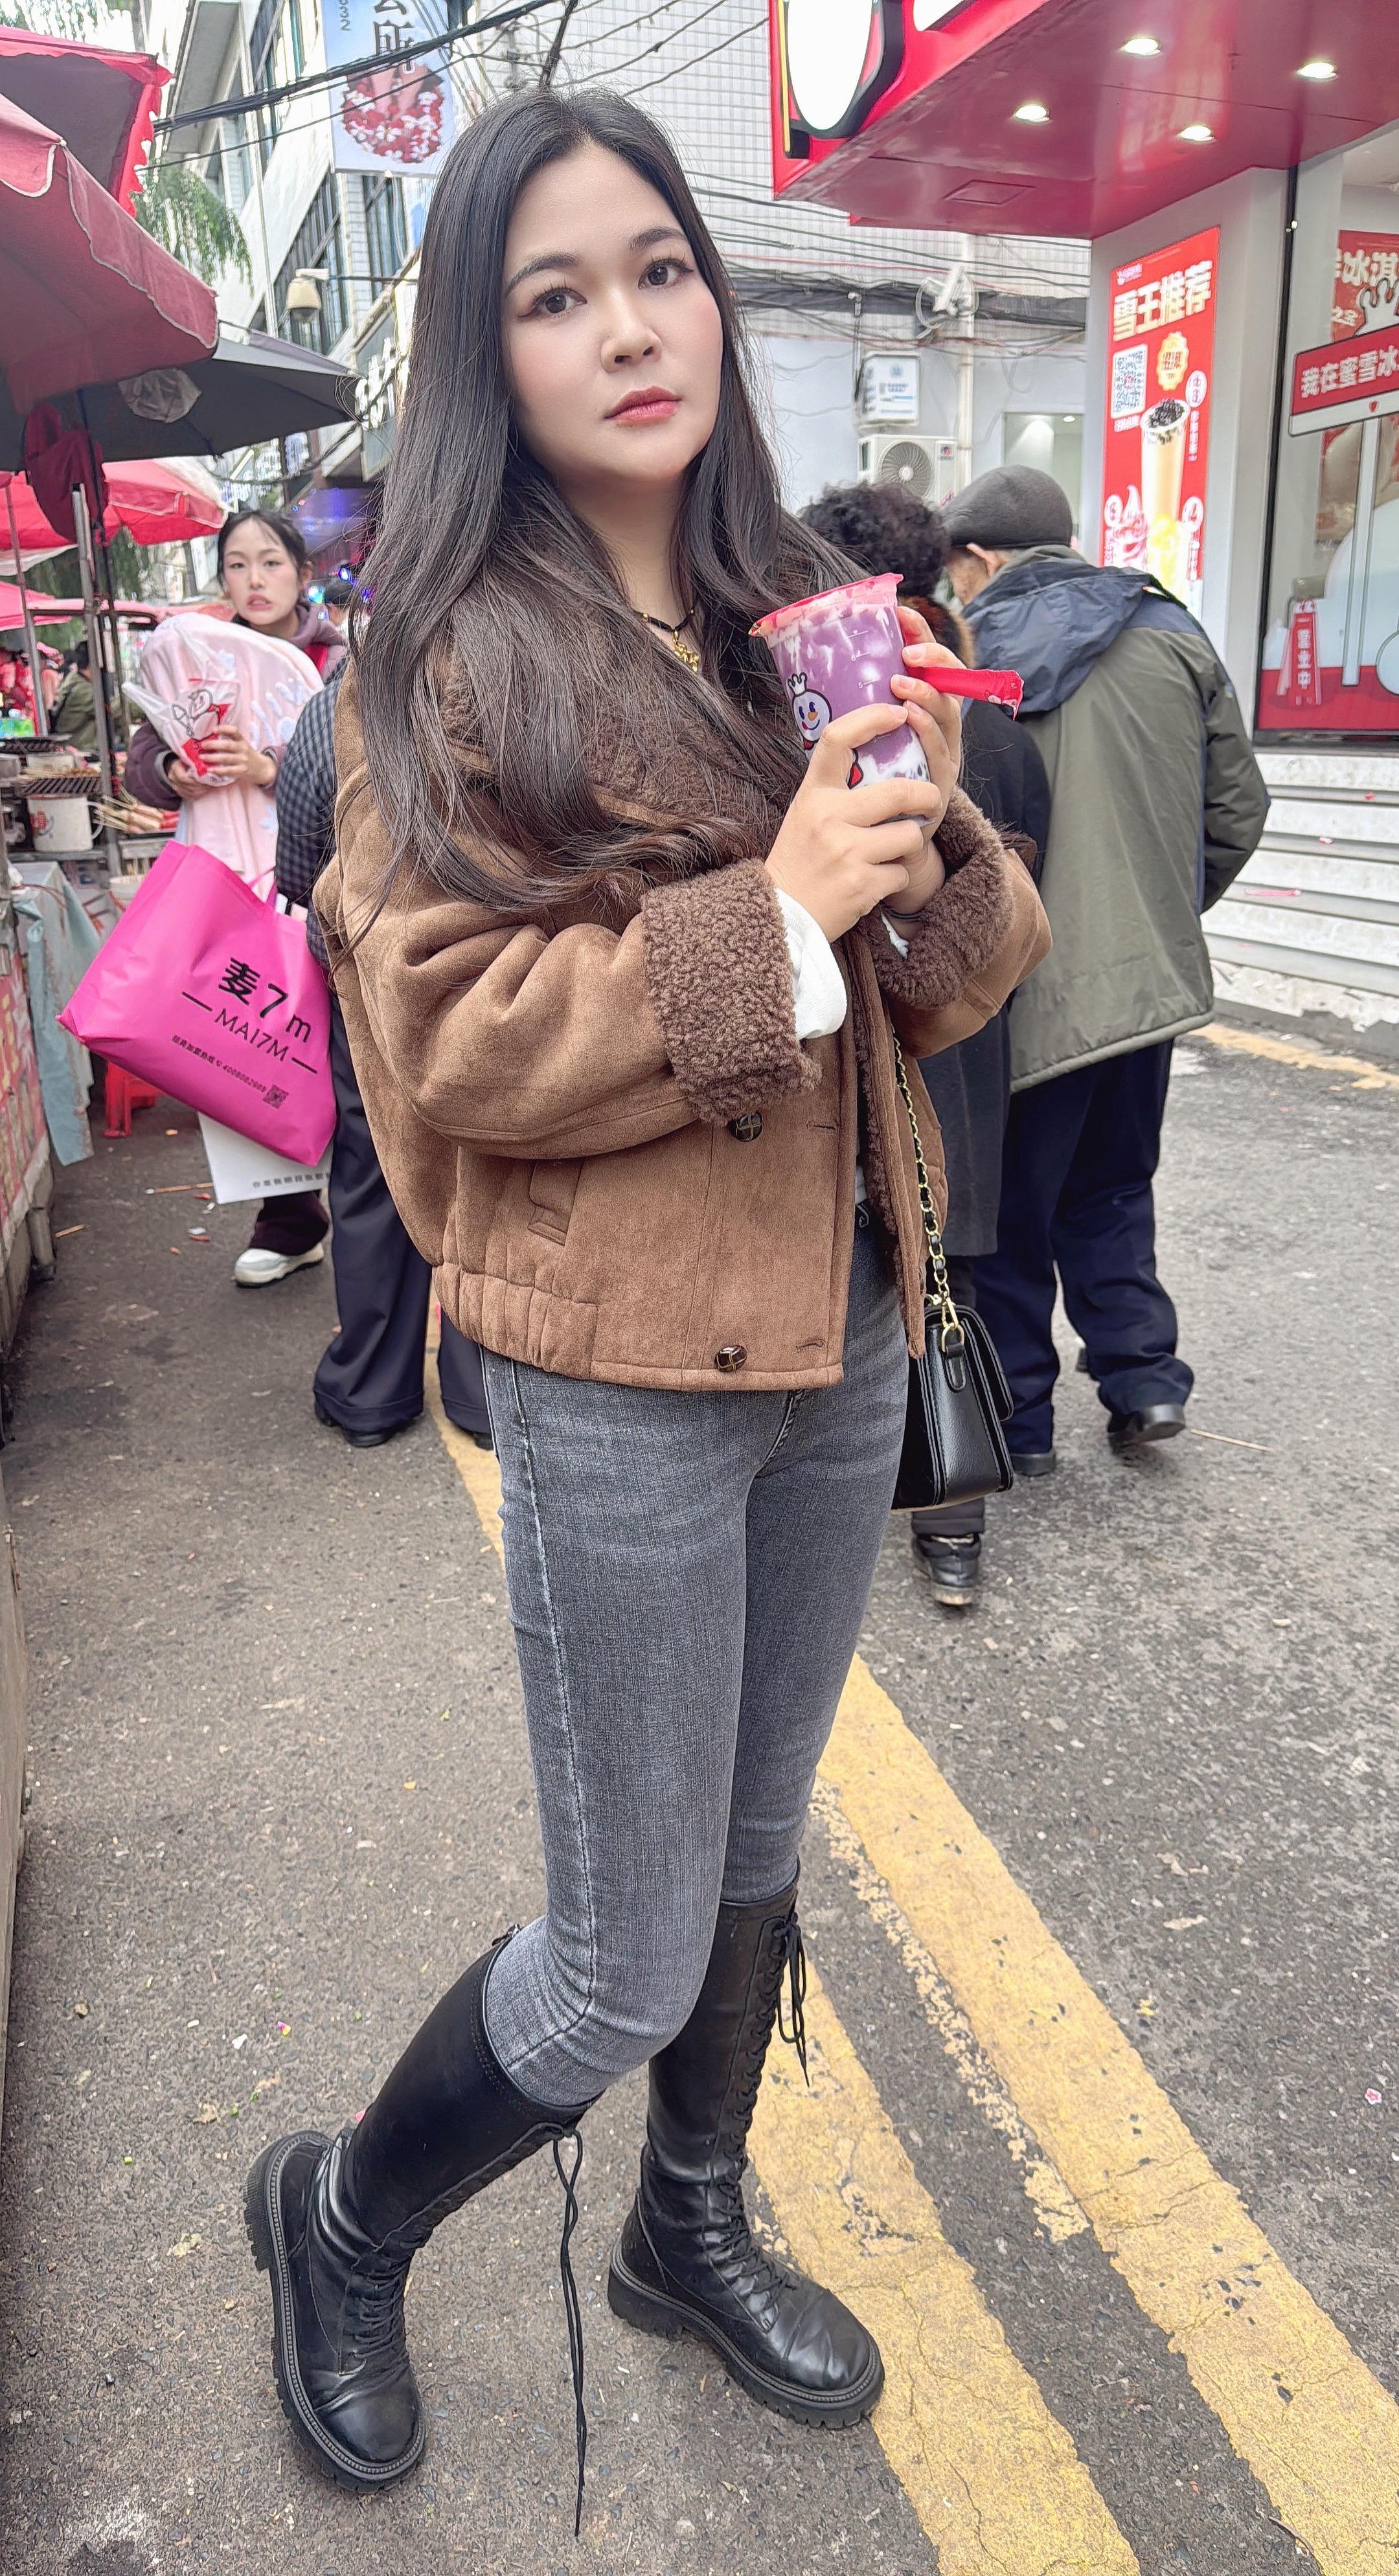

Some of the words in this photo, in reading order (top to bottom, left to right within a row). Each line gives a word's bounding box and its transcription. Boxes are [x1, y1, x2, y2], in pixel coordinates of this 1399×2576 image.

[1113, 260, 1213, 342] 雪王推荐
[1301, 345, 1399, 398] 我在蜜雪冰
[1297, 629, 1312, 690] 营业中
[214, 1008, 289, 1062] MAI7M
